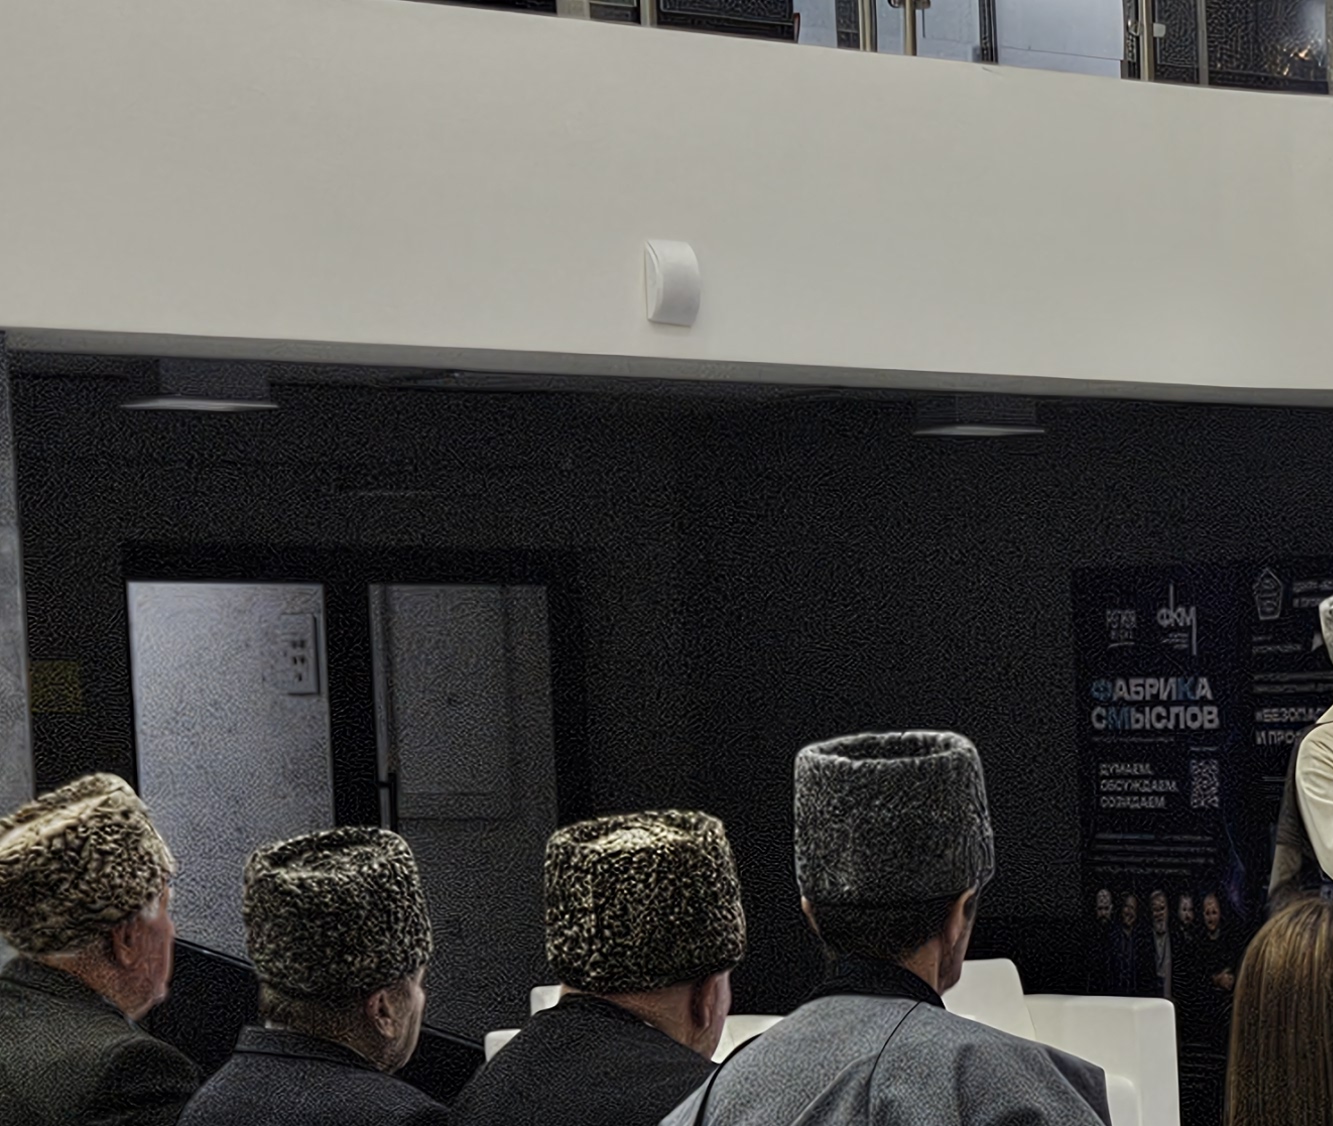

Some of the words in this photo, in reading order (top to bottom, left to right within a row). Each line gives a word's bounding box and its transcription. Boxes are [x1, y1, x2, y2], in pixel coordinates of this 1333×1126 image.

[1090, 676, 1214, 701] ФАБРИКА
[1090, 705, 1221, 730] СМЫСЛОВ
[1268, 730, 1301, 745] ПРО
